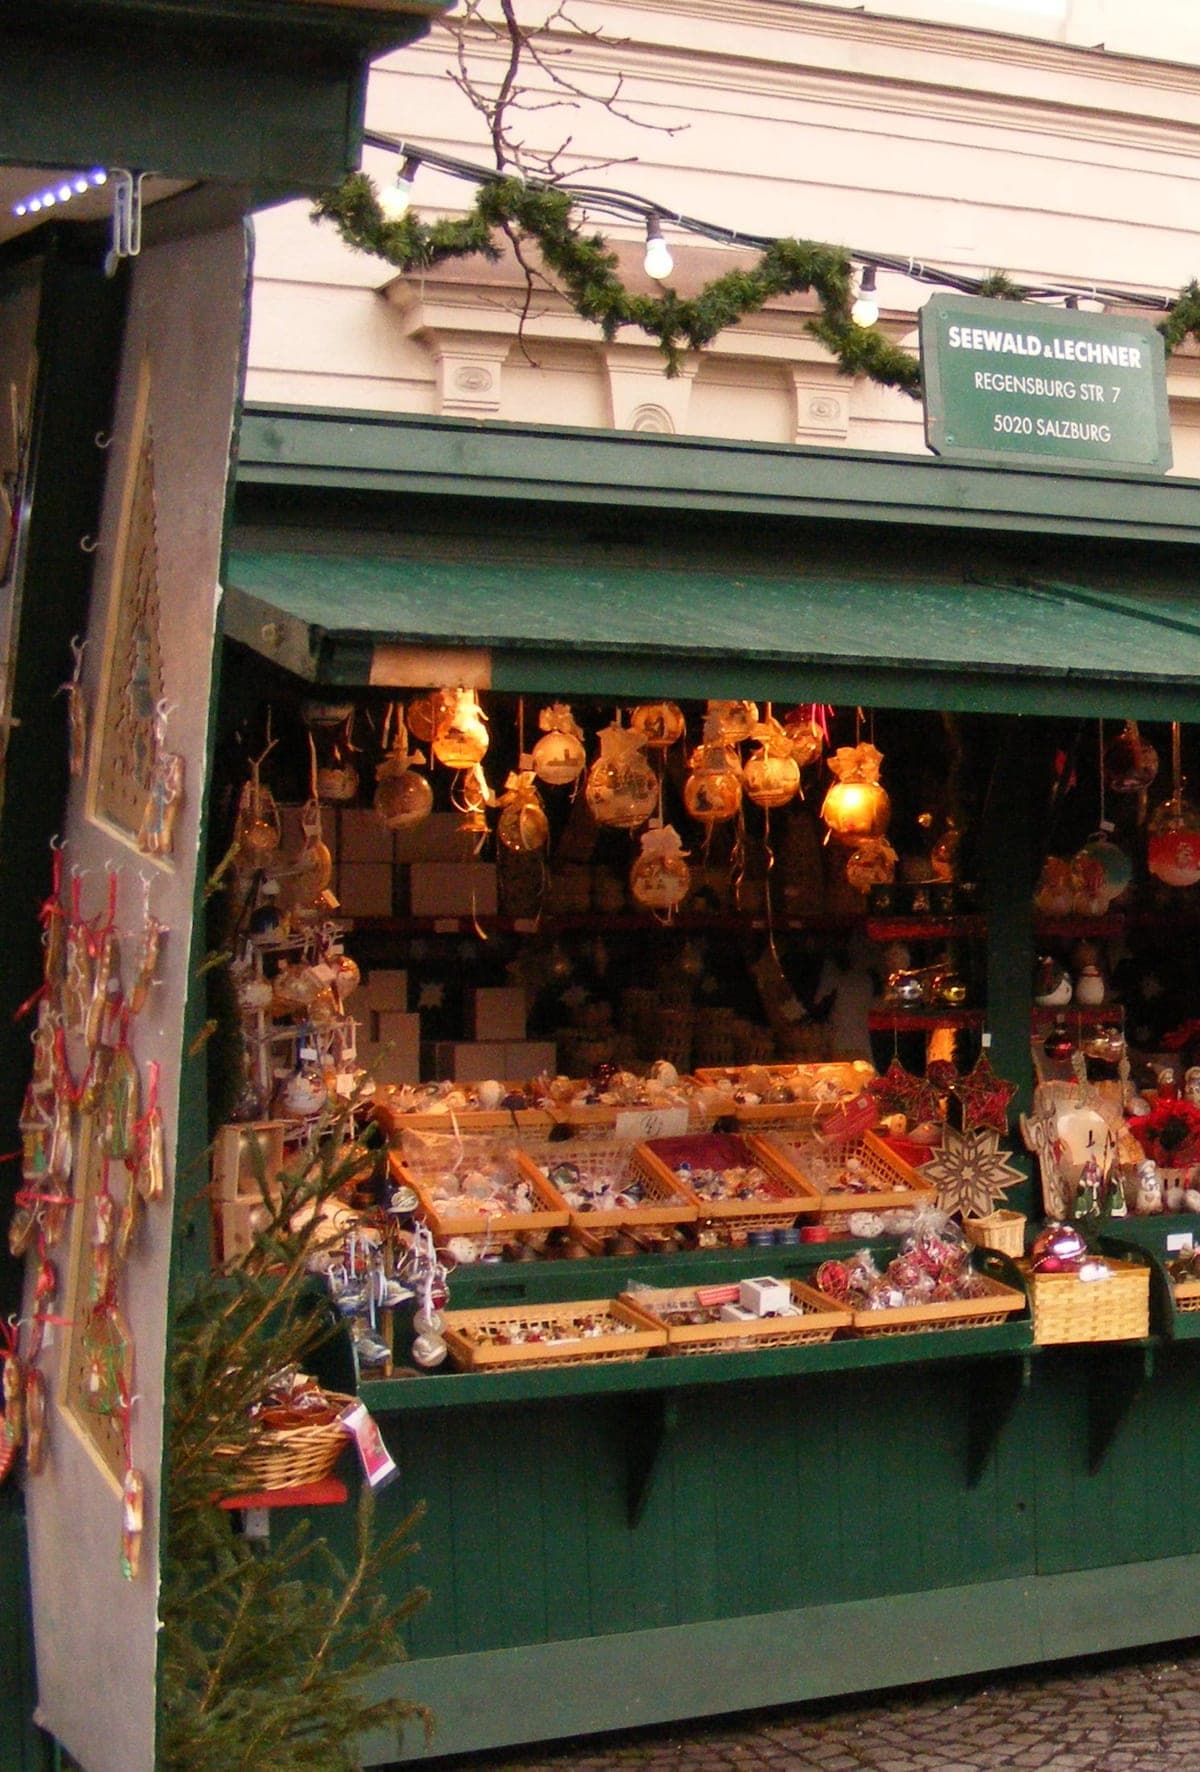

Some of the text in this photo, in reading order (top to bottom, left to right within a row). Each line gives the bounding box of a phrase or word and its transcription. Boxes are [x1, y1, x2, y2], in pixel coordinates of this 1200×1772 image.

[948, 326, 1042, 356] SEEWALD
[1053, 338, 1142, 369] LECHNER
[974, 372, 1121, 404] REGENSBURG STR 7
[993, 413, 1112, 443] 5020 SALZBURG
